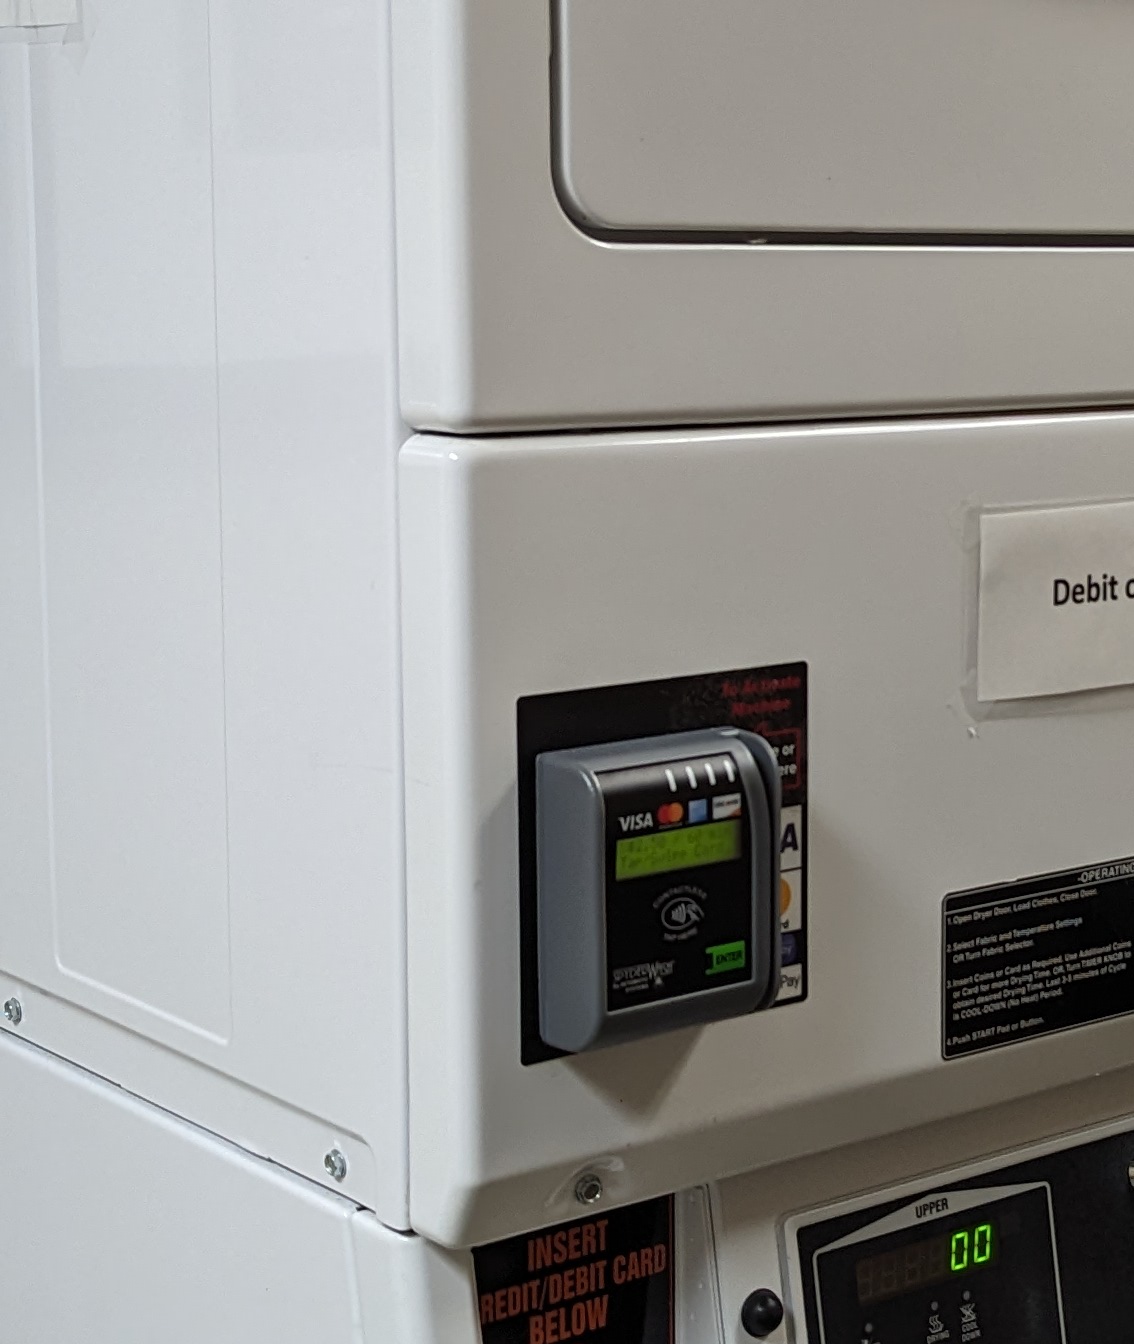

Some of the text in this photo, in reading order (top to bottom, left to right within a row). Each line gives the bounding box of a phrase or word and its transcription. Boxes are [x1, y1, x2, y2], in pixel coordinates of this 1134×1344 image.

[1053, 573, 1118, 606] Debit
[779, 763, 797, 776] ere
[618, 812, 653, 832] VISA
[915, 1198, 949, 1219] UPPER
[527, 1219, 609, 1272] INSERT
[951, 1224, 991, 1271] 00
[480, 1243, 667, 1326] REDIT/DEBIT CARD
